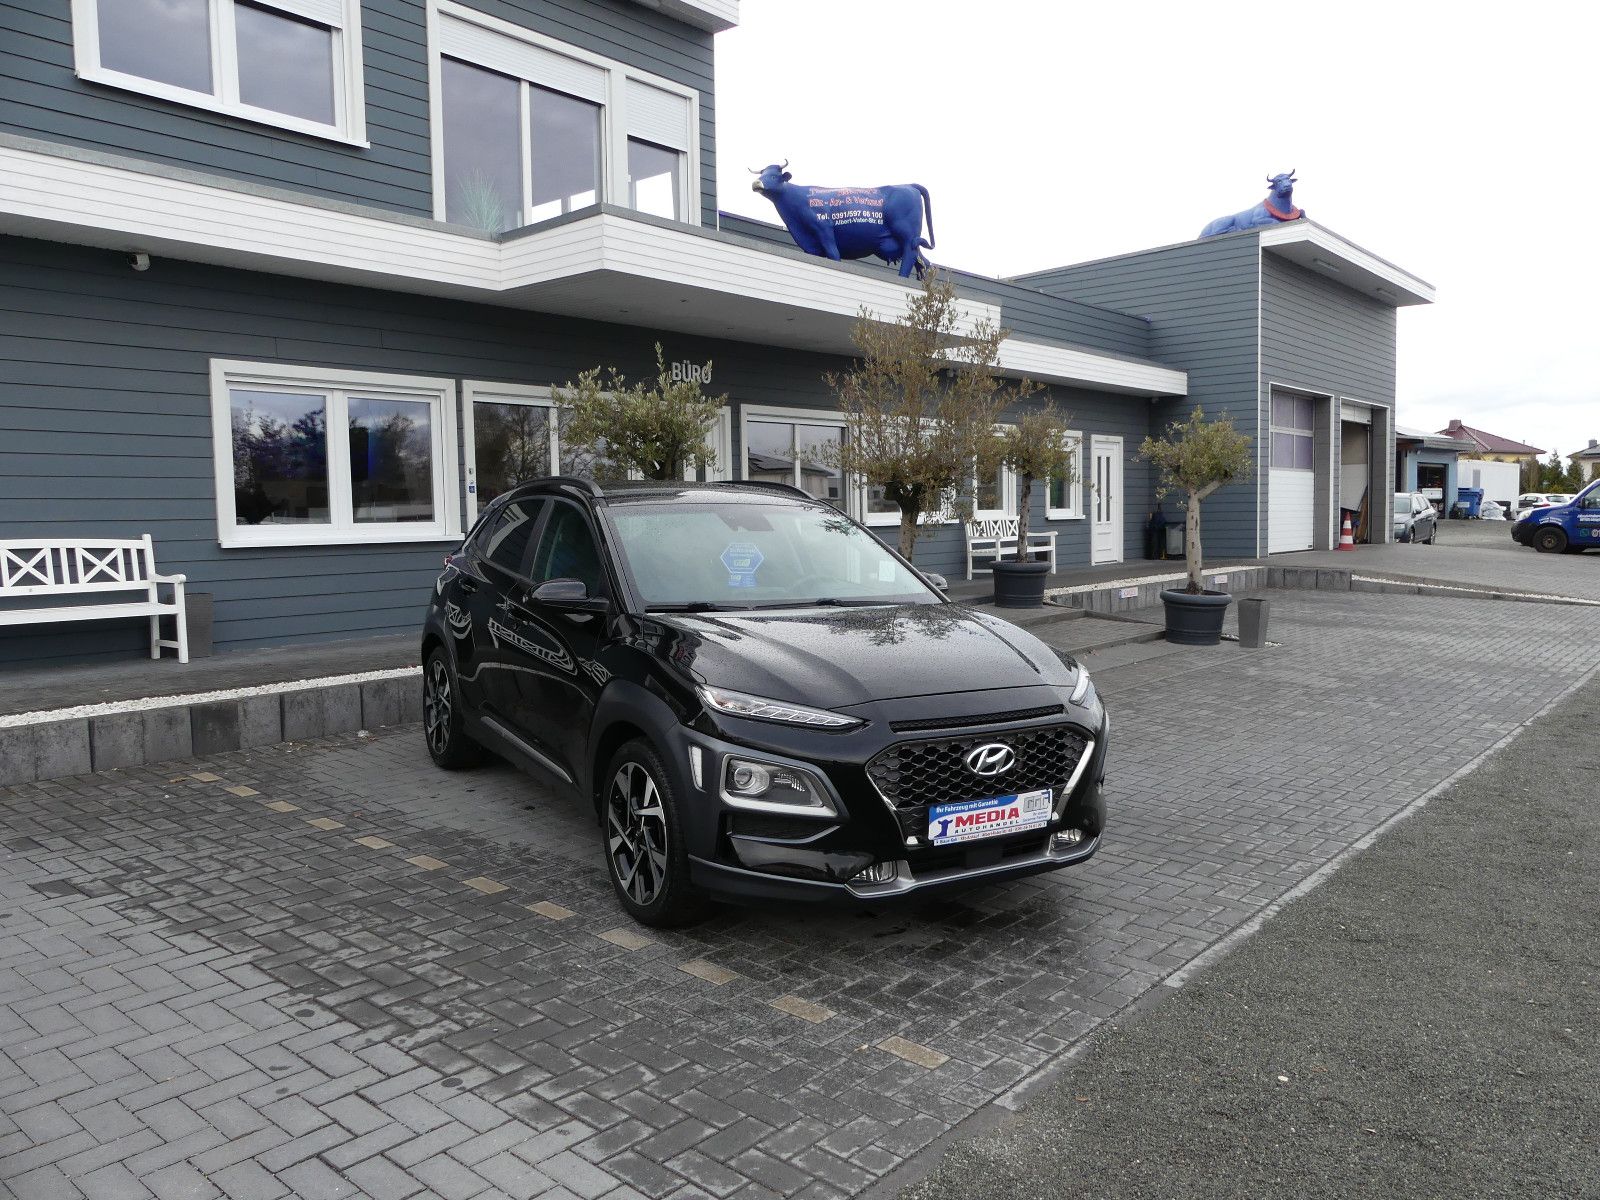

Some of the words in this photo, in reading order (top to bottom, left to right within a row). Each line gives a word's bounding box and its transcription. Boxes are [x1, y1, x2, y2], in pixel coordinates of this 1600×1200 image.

[831, 210, 861, 220] 0391/597
[672, 360, 712, 384] BÜRO
[944, 804, 969, 813] Fahrzeug
[978, 799, 999, 808] Garantie
[955, 807, 1020, 828] MEDIA
[954, 819, 1020, 834] AUTOHANDEL
